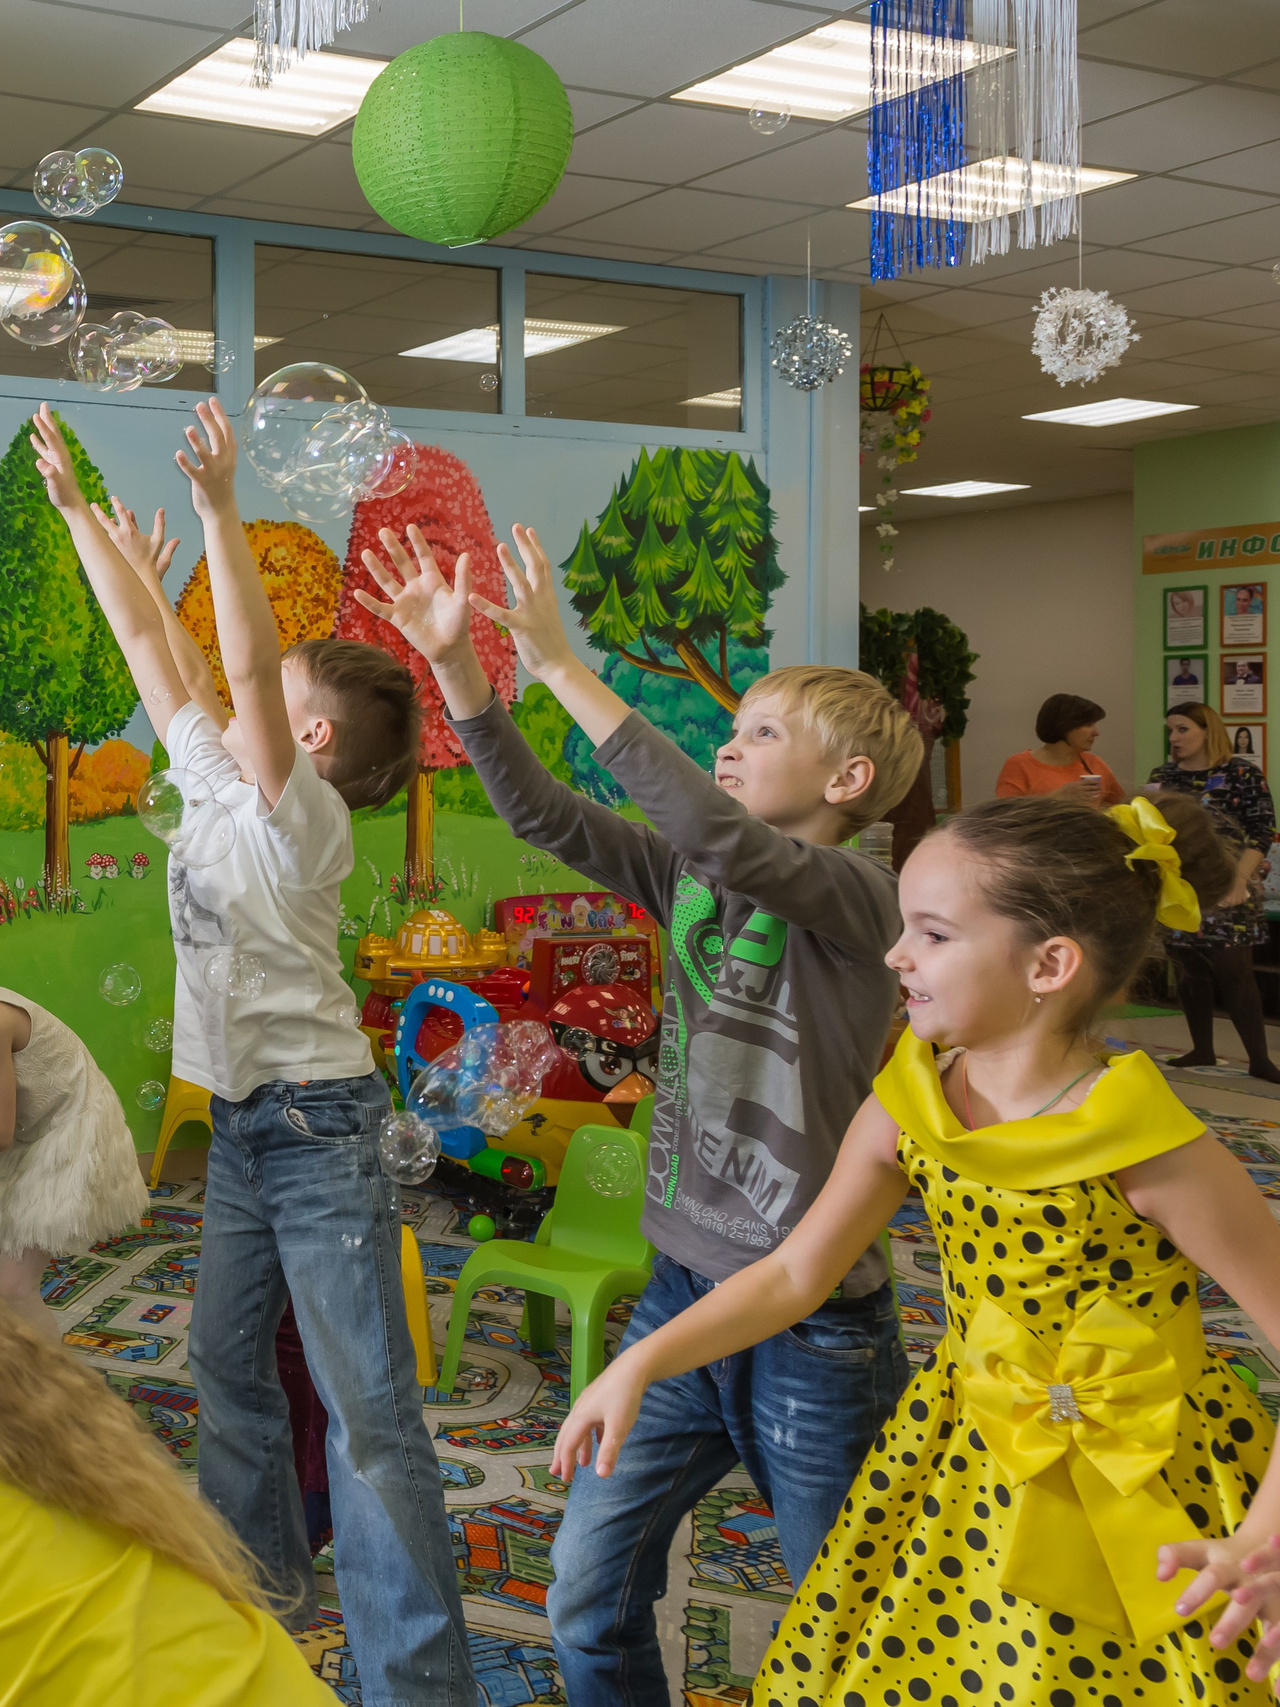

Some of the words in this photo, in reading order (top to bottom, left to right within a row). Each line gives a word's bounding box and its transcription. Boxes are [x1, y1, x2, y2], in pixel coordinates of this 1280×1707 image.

[514, 906, 534, 923] 92
[538, 911, 574, 930] FUN
[587, 910, 626, 929] PARK
[663, 1153, 680, 1209] DOWNLOAD
[676, 1187, 728, 1222] DWNLOAD
[727, 1216, 768, 1237] JEANS
[773, 1226, 796, 1239] 19
